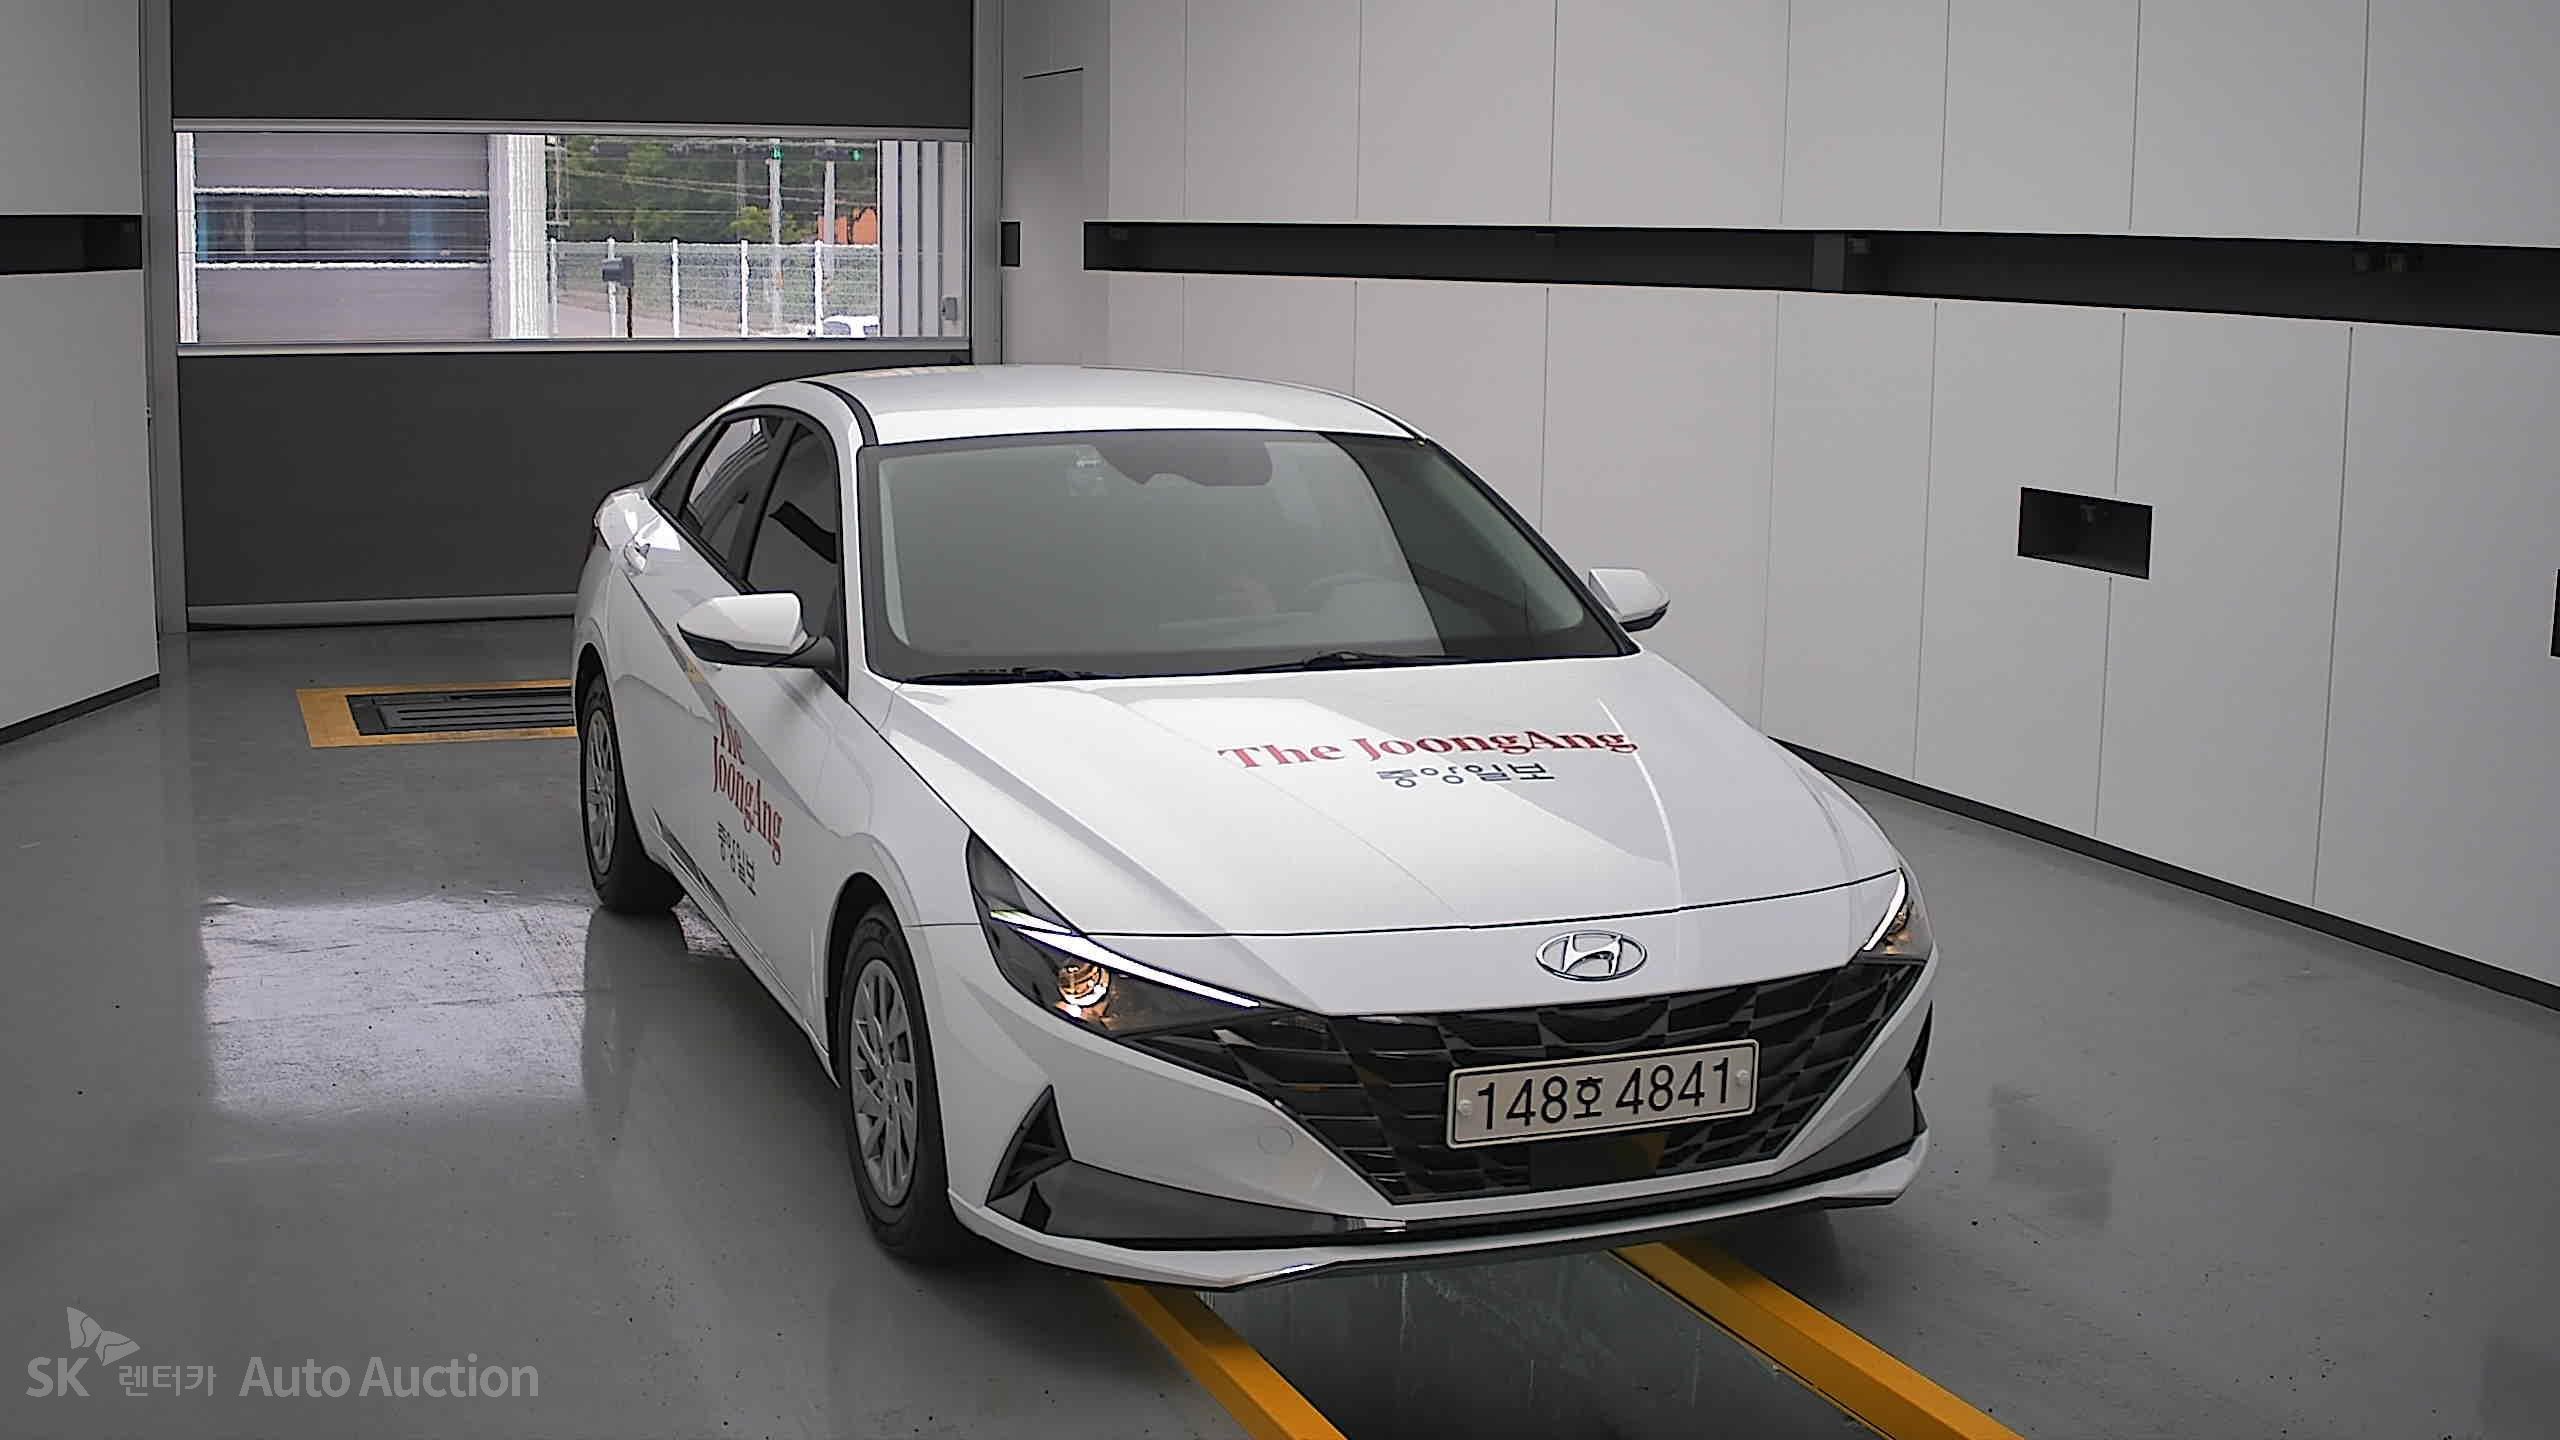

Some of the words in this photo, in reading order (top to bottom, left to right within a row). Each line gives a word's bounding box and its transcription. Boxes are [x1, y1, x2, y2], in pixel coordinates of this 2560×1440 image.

[714, 701, 745, 766] The
[1218, 744, 1344, 768] The
[1350, 731, 1639, 763] JoongAng
[713, 735, 783, 866] JoongAng
[1376, 762, 1555, 788] 중앙일보
[1477, 1076, 1603, 1131] 148호
[1615, 1057, 1731, 1115] 4841
